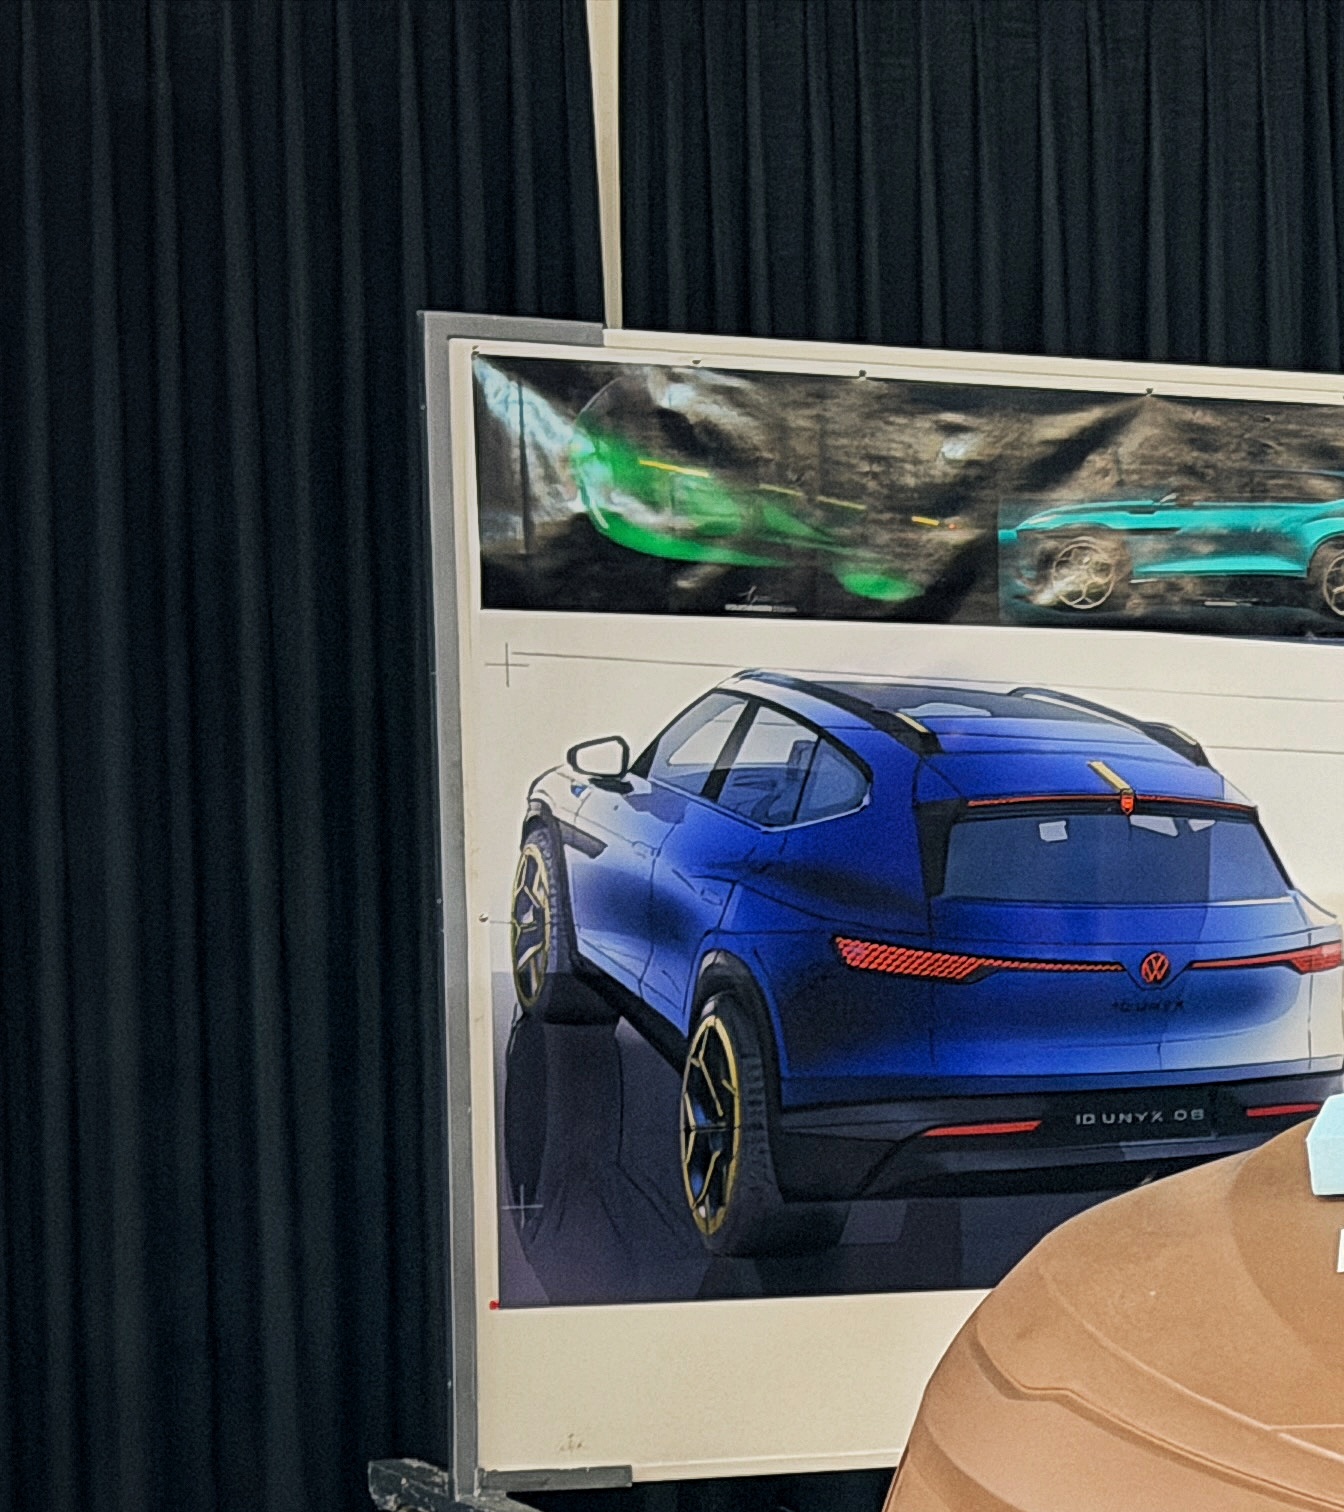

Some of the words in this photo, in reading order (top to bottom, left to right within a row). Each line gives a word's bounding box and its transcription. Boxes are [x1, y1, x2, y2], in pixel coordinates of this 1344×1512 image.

[1141, 952, 1169, 984] VW
[1076, 1113, 1096, 1125] ID
[1102, 1110, 1163, 1124] UNYX
